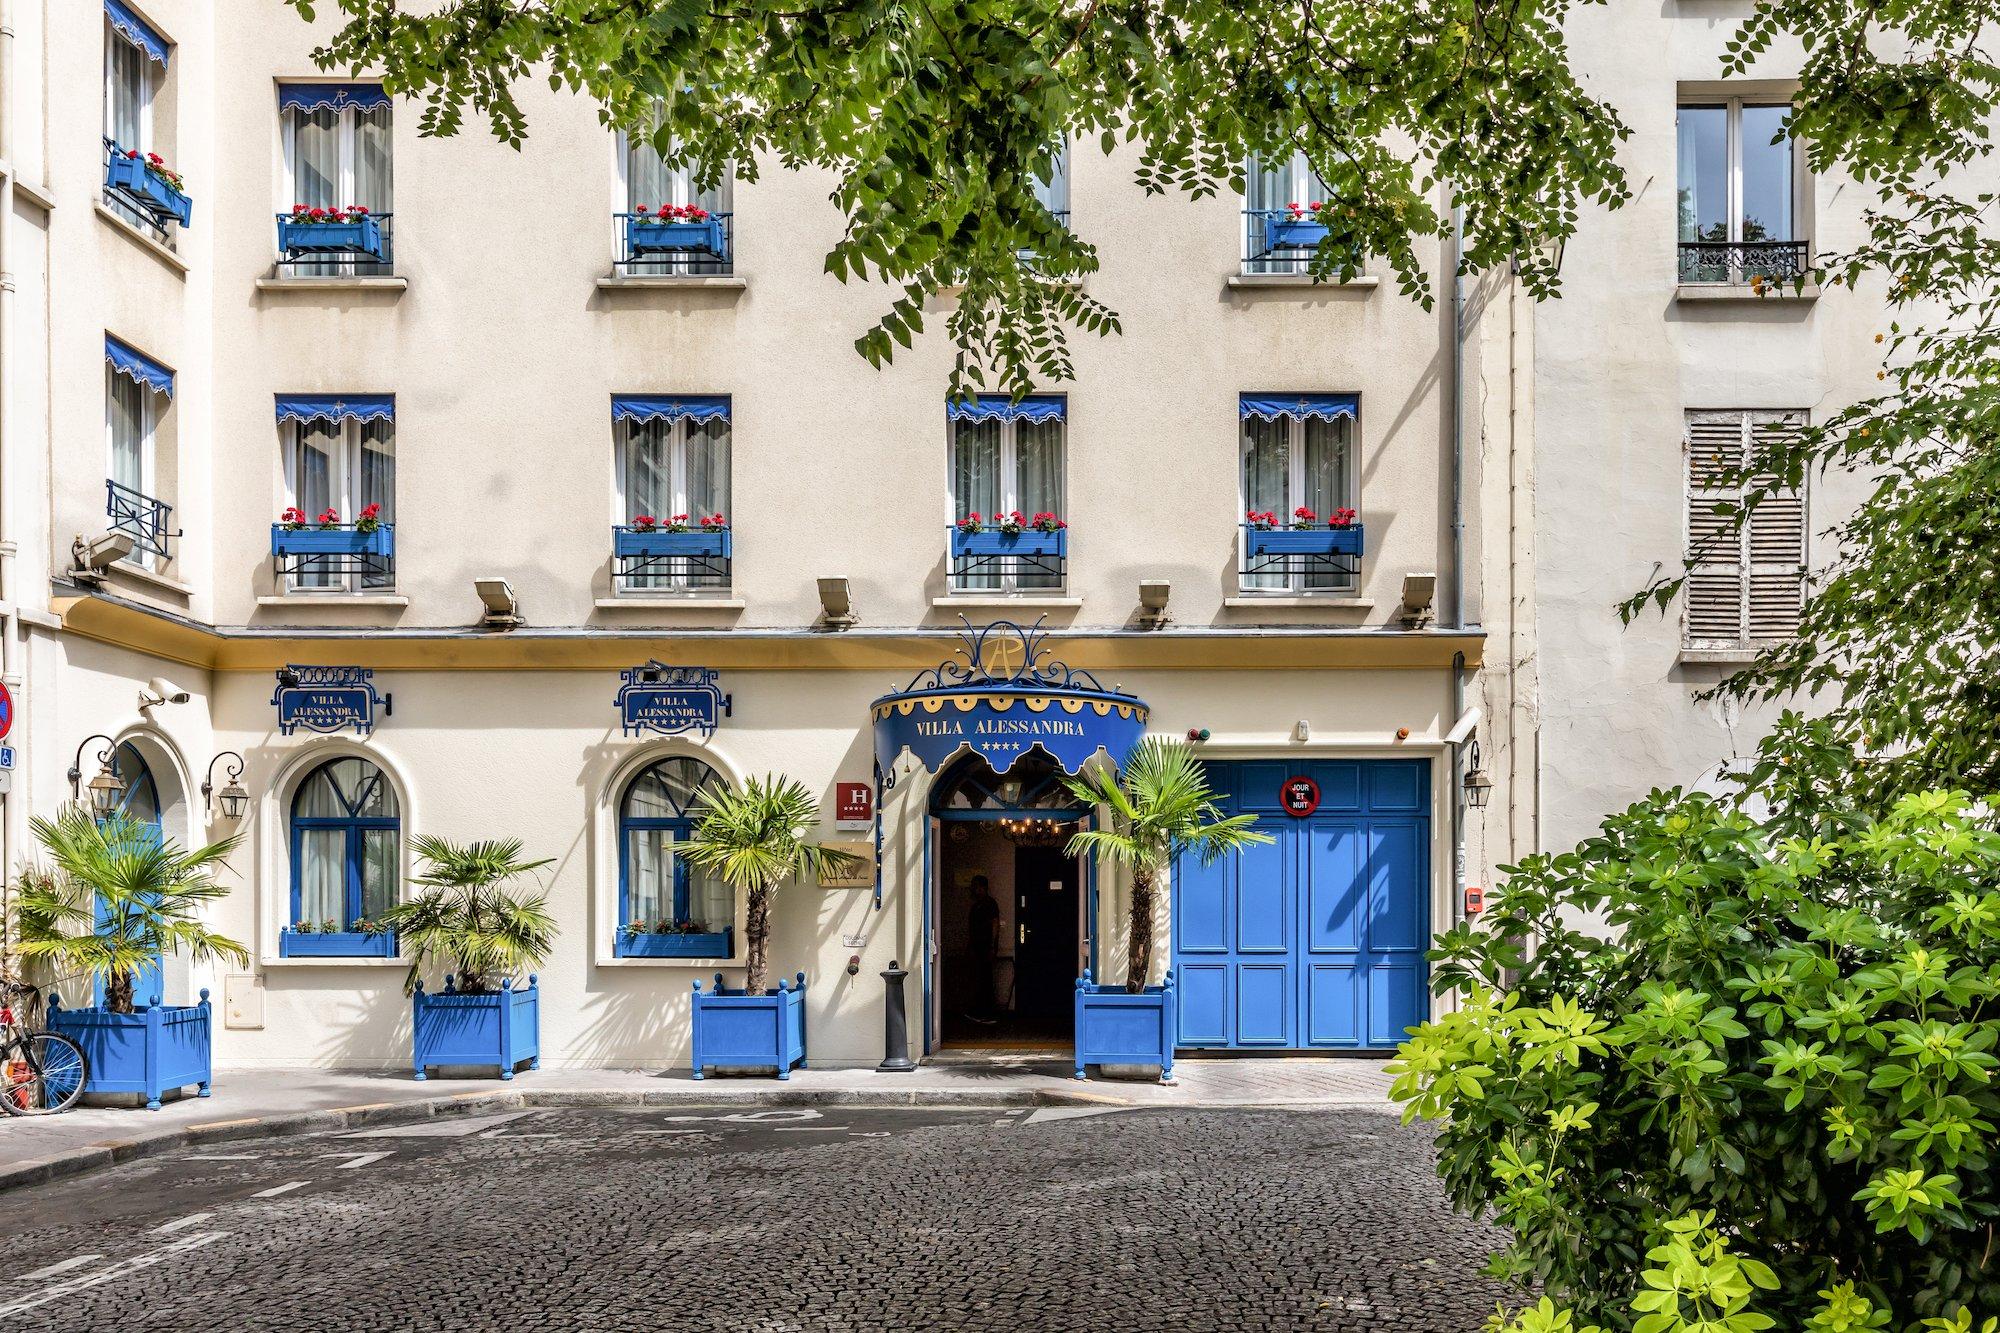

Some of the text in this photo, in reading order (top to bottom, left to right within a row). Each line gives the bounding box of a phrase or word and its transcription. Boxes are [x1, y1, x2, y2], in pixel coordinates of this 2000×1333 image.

[312, 696, 344, 704] VILLA
[654, 697, 688, 706] VILLA
[292, 707, 360, 716] ALESSANDRA
[636, 708, 704, 717] ALESSANDRA
[917, 719, 1085, 736] VILLA ALESSANDRA
[851, 790, 868, 804] H
